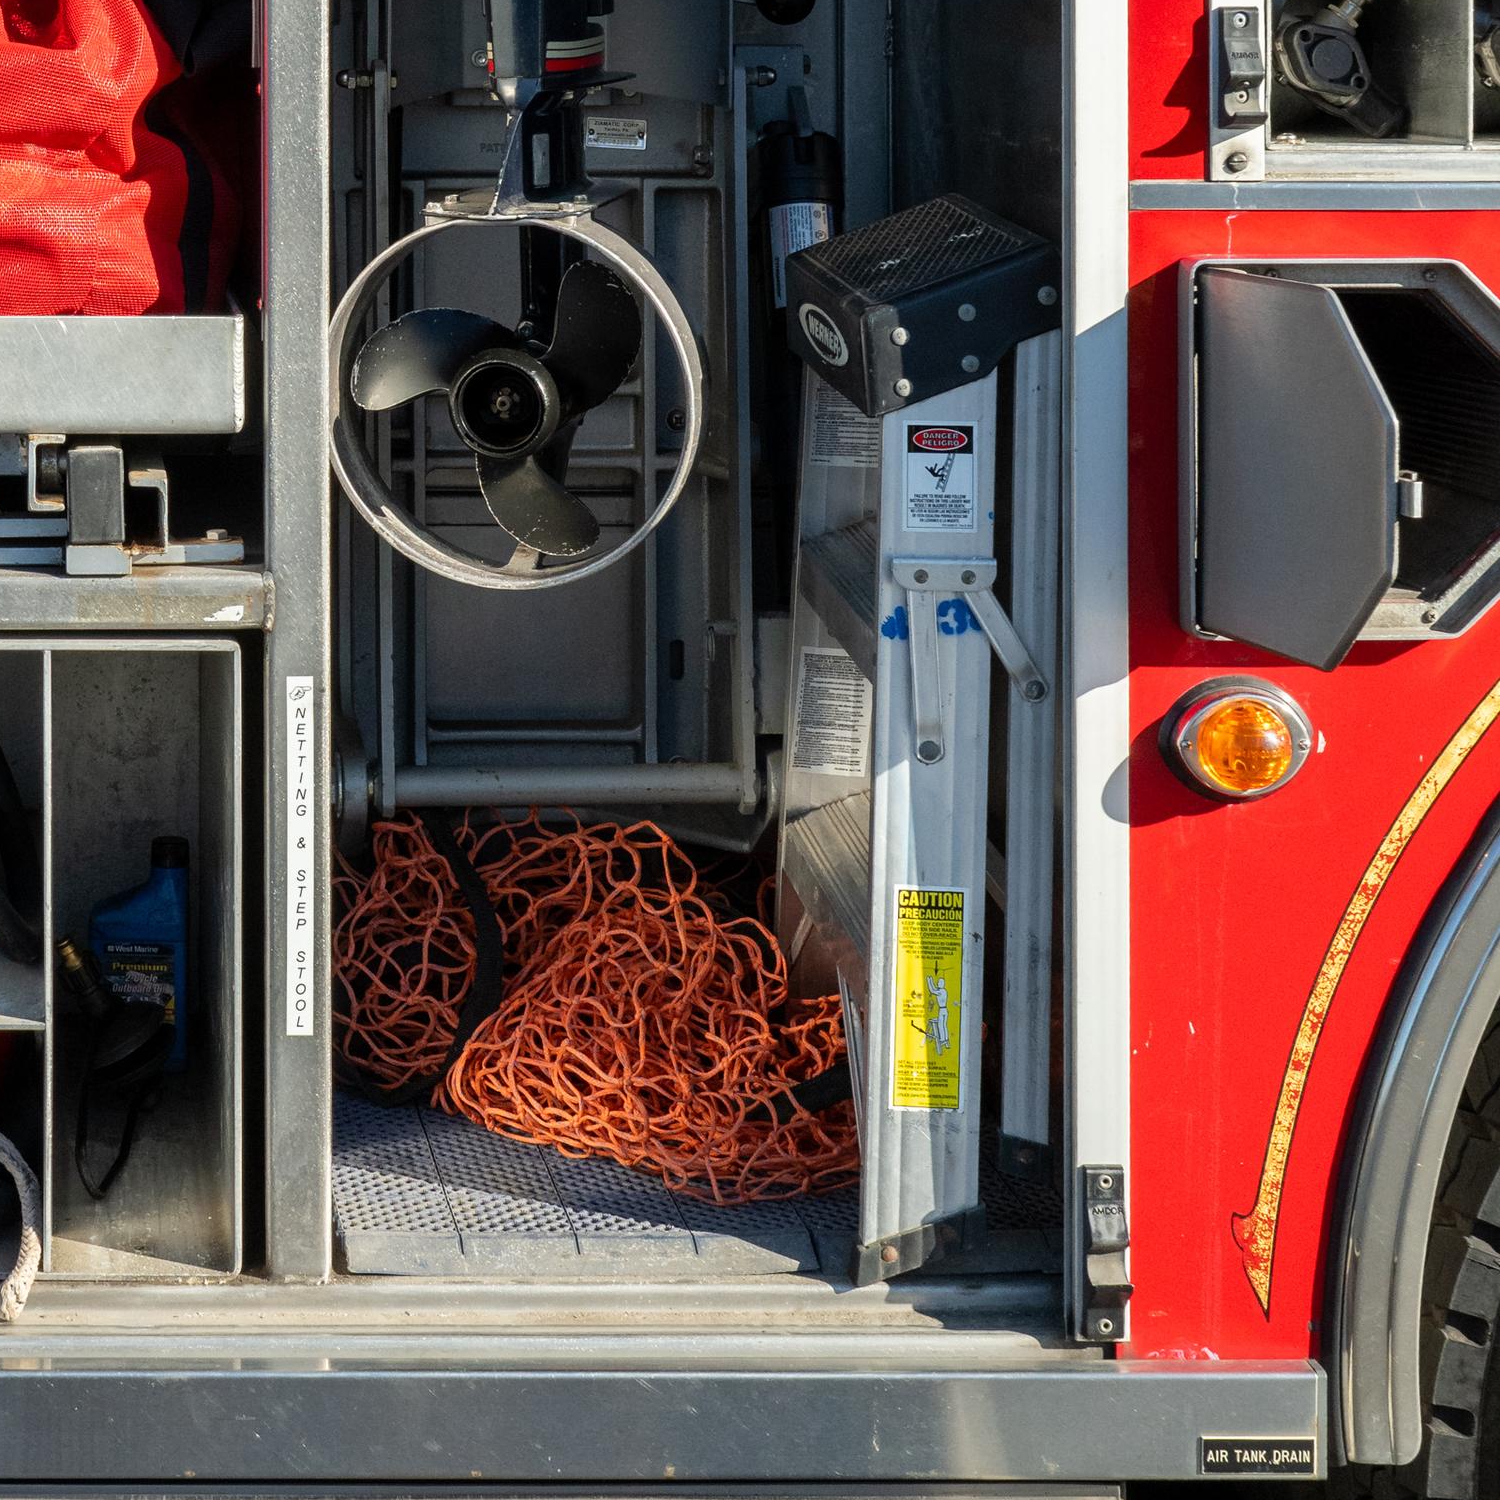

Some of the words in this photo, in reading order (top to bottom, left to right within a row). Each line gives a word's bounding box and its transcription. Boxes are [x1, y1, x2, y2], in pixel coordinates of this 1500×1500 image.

[808, 313, 842, 355] WERNER
[295, 707, 307, 817] NETTING
[296, 836, 306, 849] &
[296, 869, 307, 930] STEP
[898, 890, 963, 908] CAUTION
[898, 907, 962, 920] PRECAUCIÓN
[111, 962, 168, 972] Premium
[295, 950, 307, 1028] STOOL
[1206, 1449, 1229, 1463] AIR
[1234, 1449, 1267, 1463] TANK
[1273, 1449, 1311, 1463] DRAIN
